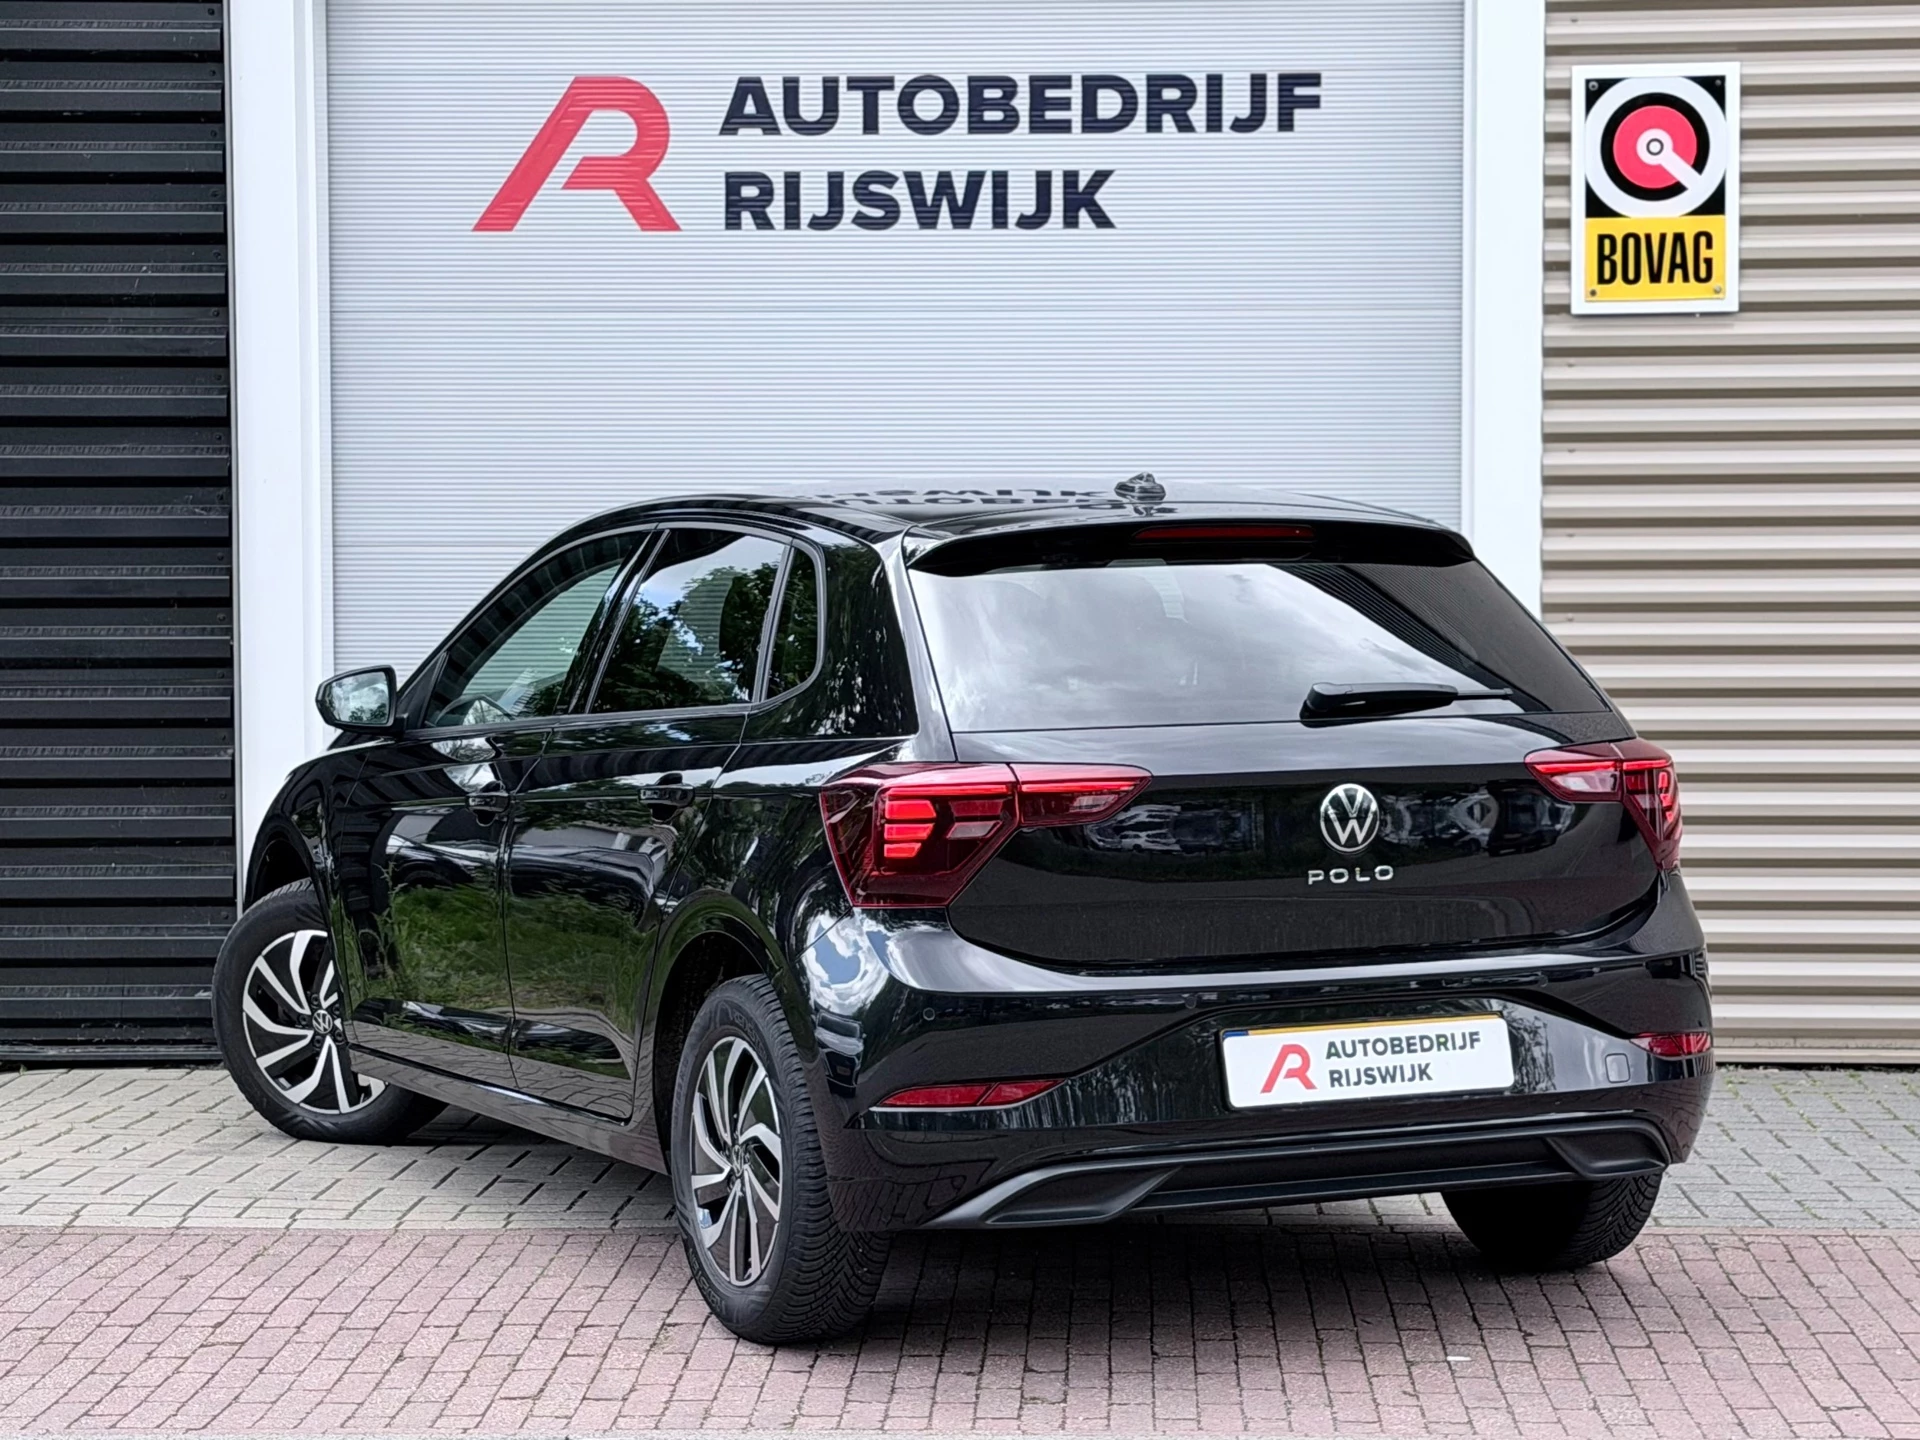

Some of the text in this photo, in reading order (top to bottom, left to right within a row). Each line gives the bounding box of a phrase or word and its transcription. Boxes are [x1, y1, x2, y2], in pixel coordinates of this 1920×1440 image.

[718, 72, 1322, 136] AUTOBEDRIJF
[724, 169, 1117, 231] RIJSWIJK
[1596, 230, 1714, 286] BOVAG
[1307, 864, 1395, 885] POLO
[1325, 1031, 1482, 1060] AUTOBEDRIJF
[1328, 1062, 1434, 1089] RIJSWIJK
